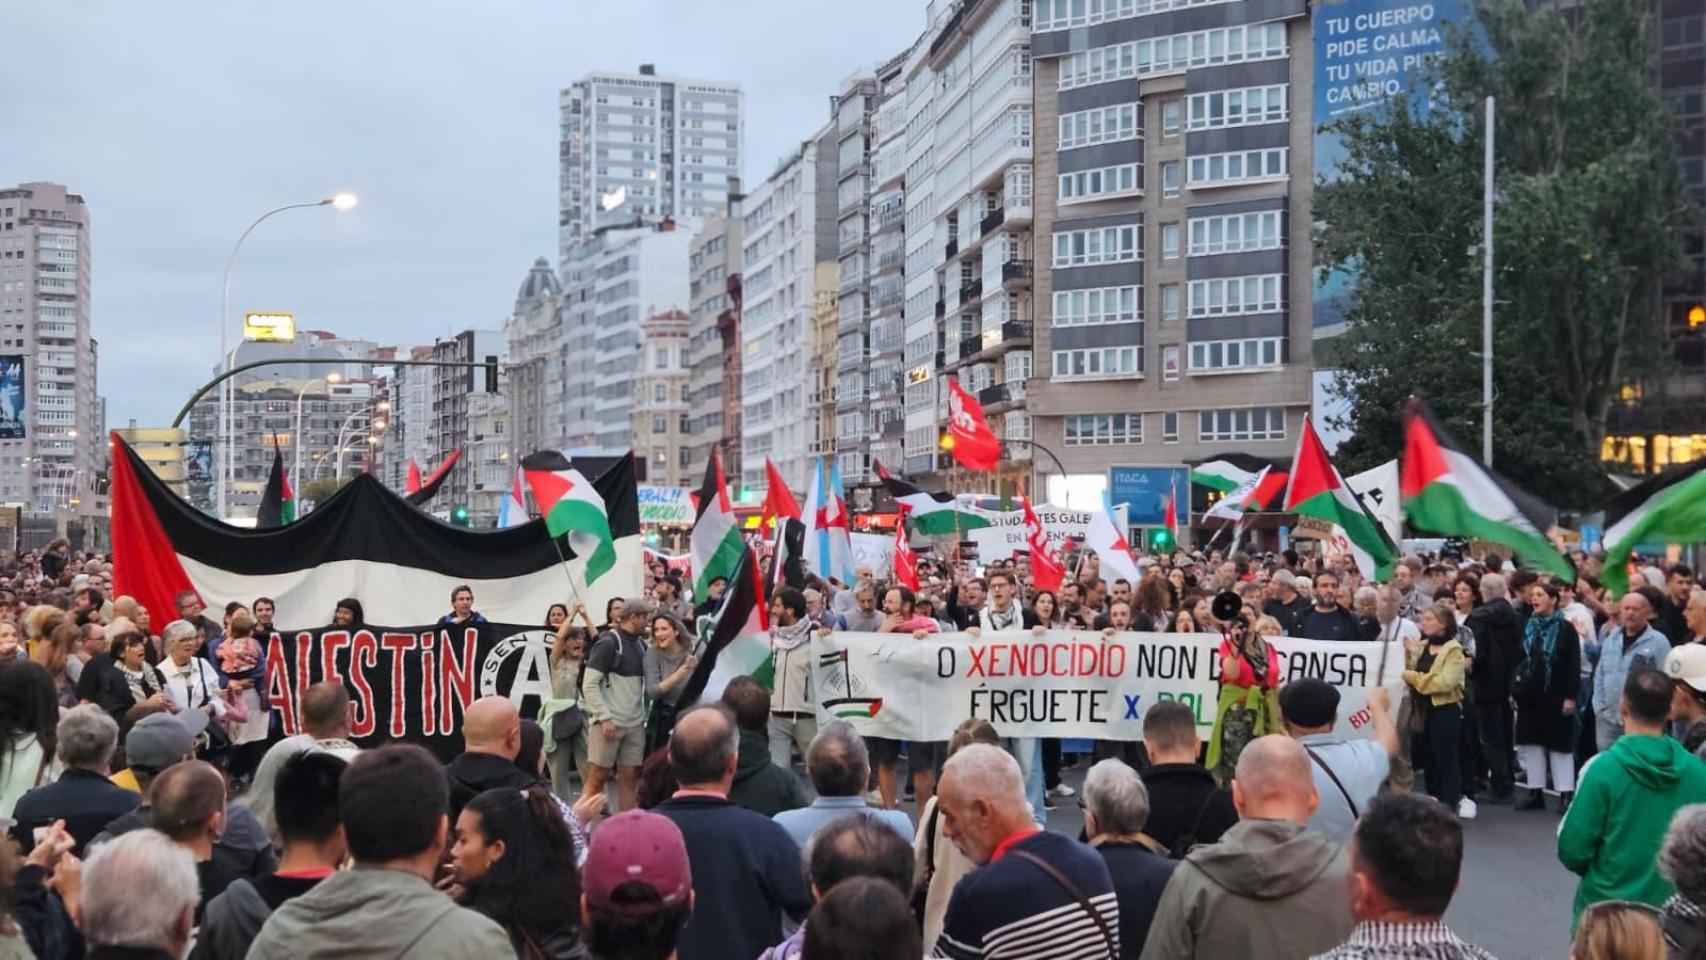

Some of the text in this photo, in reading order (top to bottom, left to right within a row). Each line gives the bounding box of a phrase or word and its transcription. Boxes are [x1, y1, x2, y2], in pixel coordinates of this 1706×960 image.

[1326, 4, 1434, 35] TU CUERPO
[1326, 28, 1441, 59] PIDE CALMA
[1326, 64, 1350, 82] TU
[1354, 58, 1399, 76] VIDA
[1006, 533, 1022, 543] EN
[937, 646, 956, 678] O
[1136, 644, 1198, 680] NON
[970, 682, 1108, 723] ÉRGUETE
[1124, 694, 1140, 720] X
[1348, 704, 1371, 730] BD
